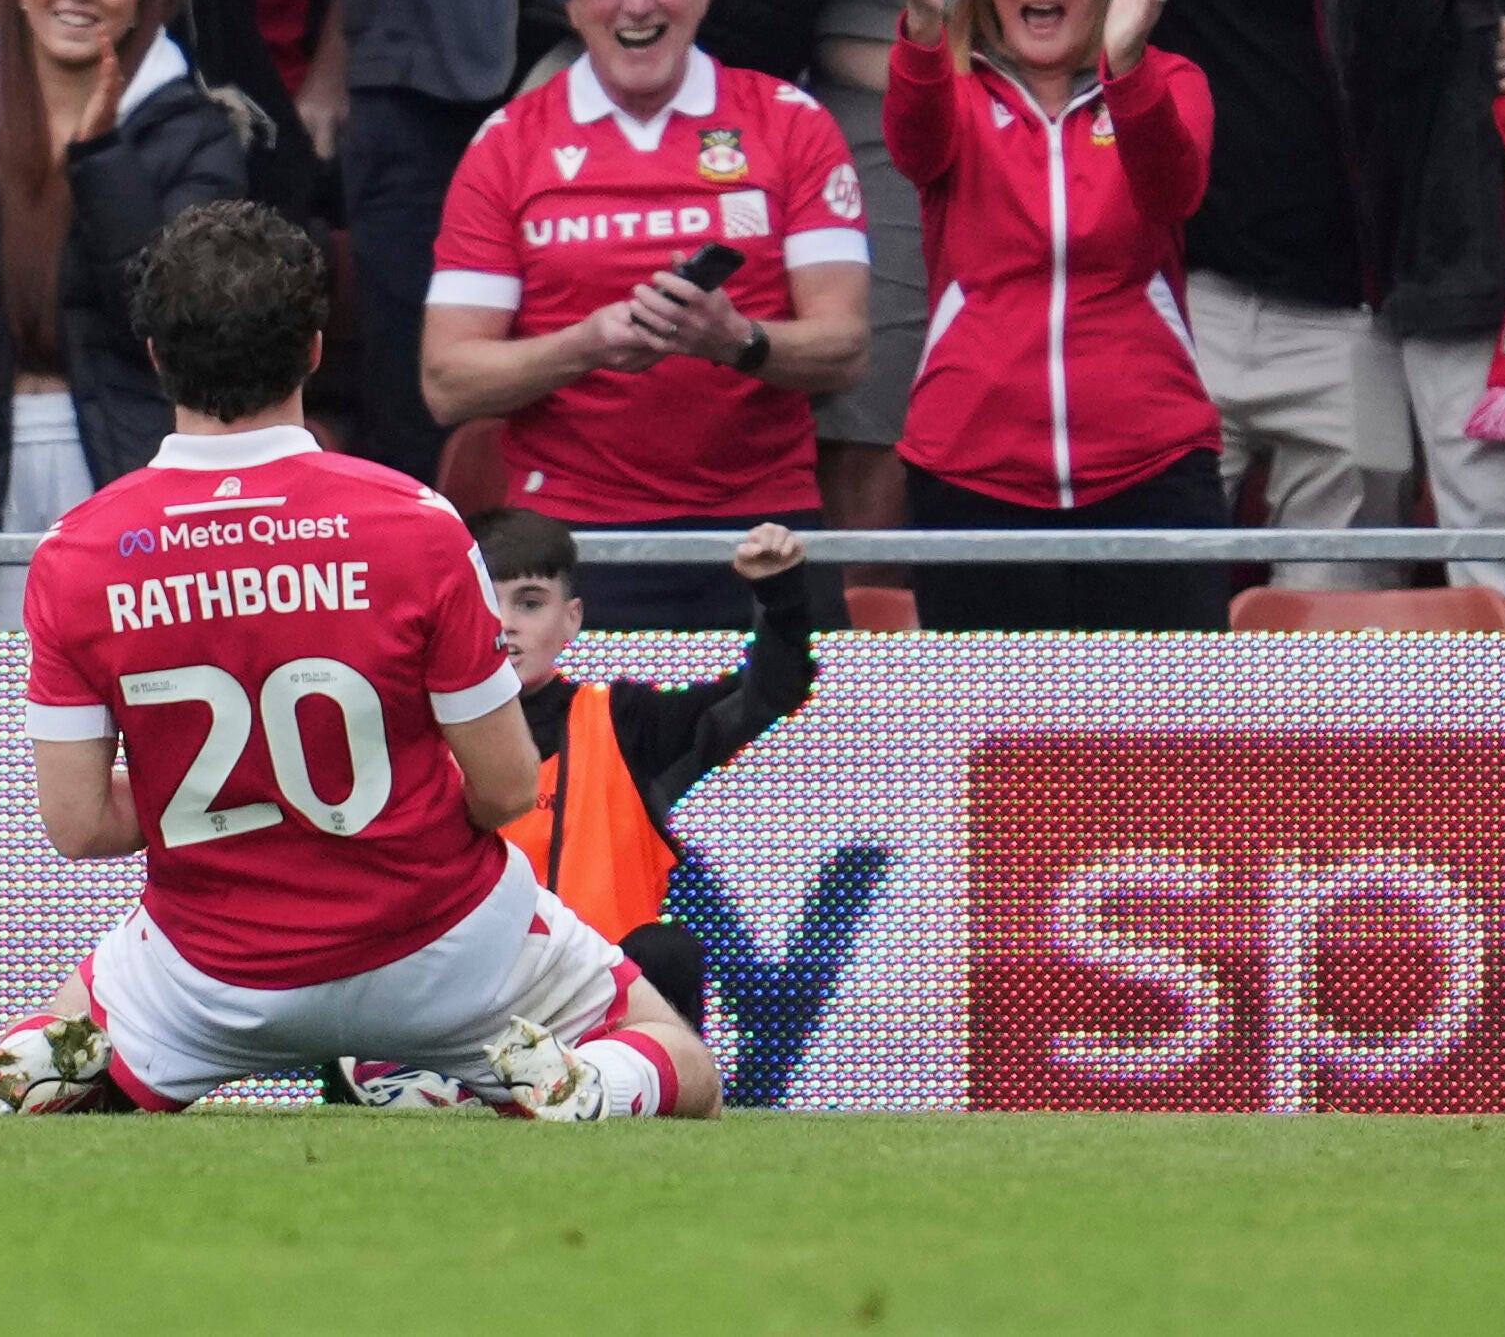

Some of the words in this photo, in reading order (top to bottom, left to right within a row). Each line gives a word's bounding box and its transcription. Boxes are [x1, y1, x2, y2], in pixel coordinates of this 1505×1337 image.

[523, 207, 711, 247] UNITED
[159, 515, 244, 553] Meta
[251, 512, 351, 548] Quest
[105, 562, 371, 635] RATHBONE
[118, 657, 393, 850] 20
